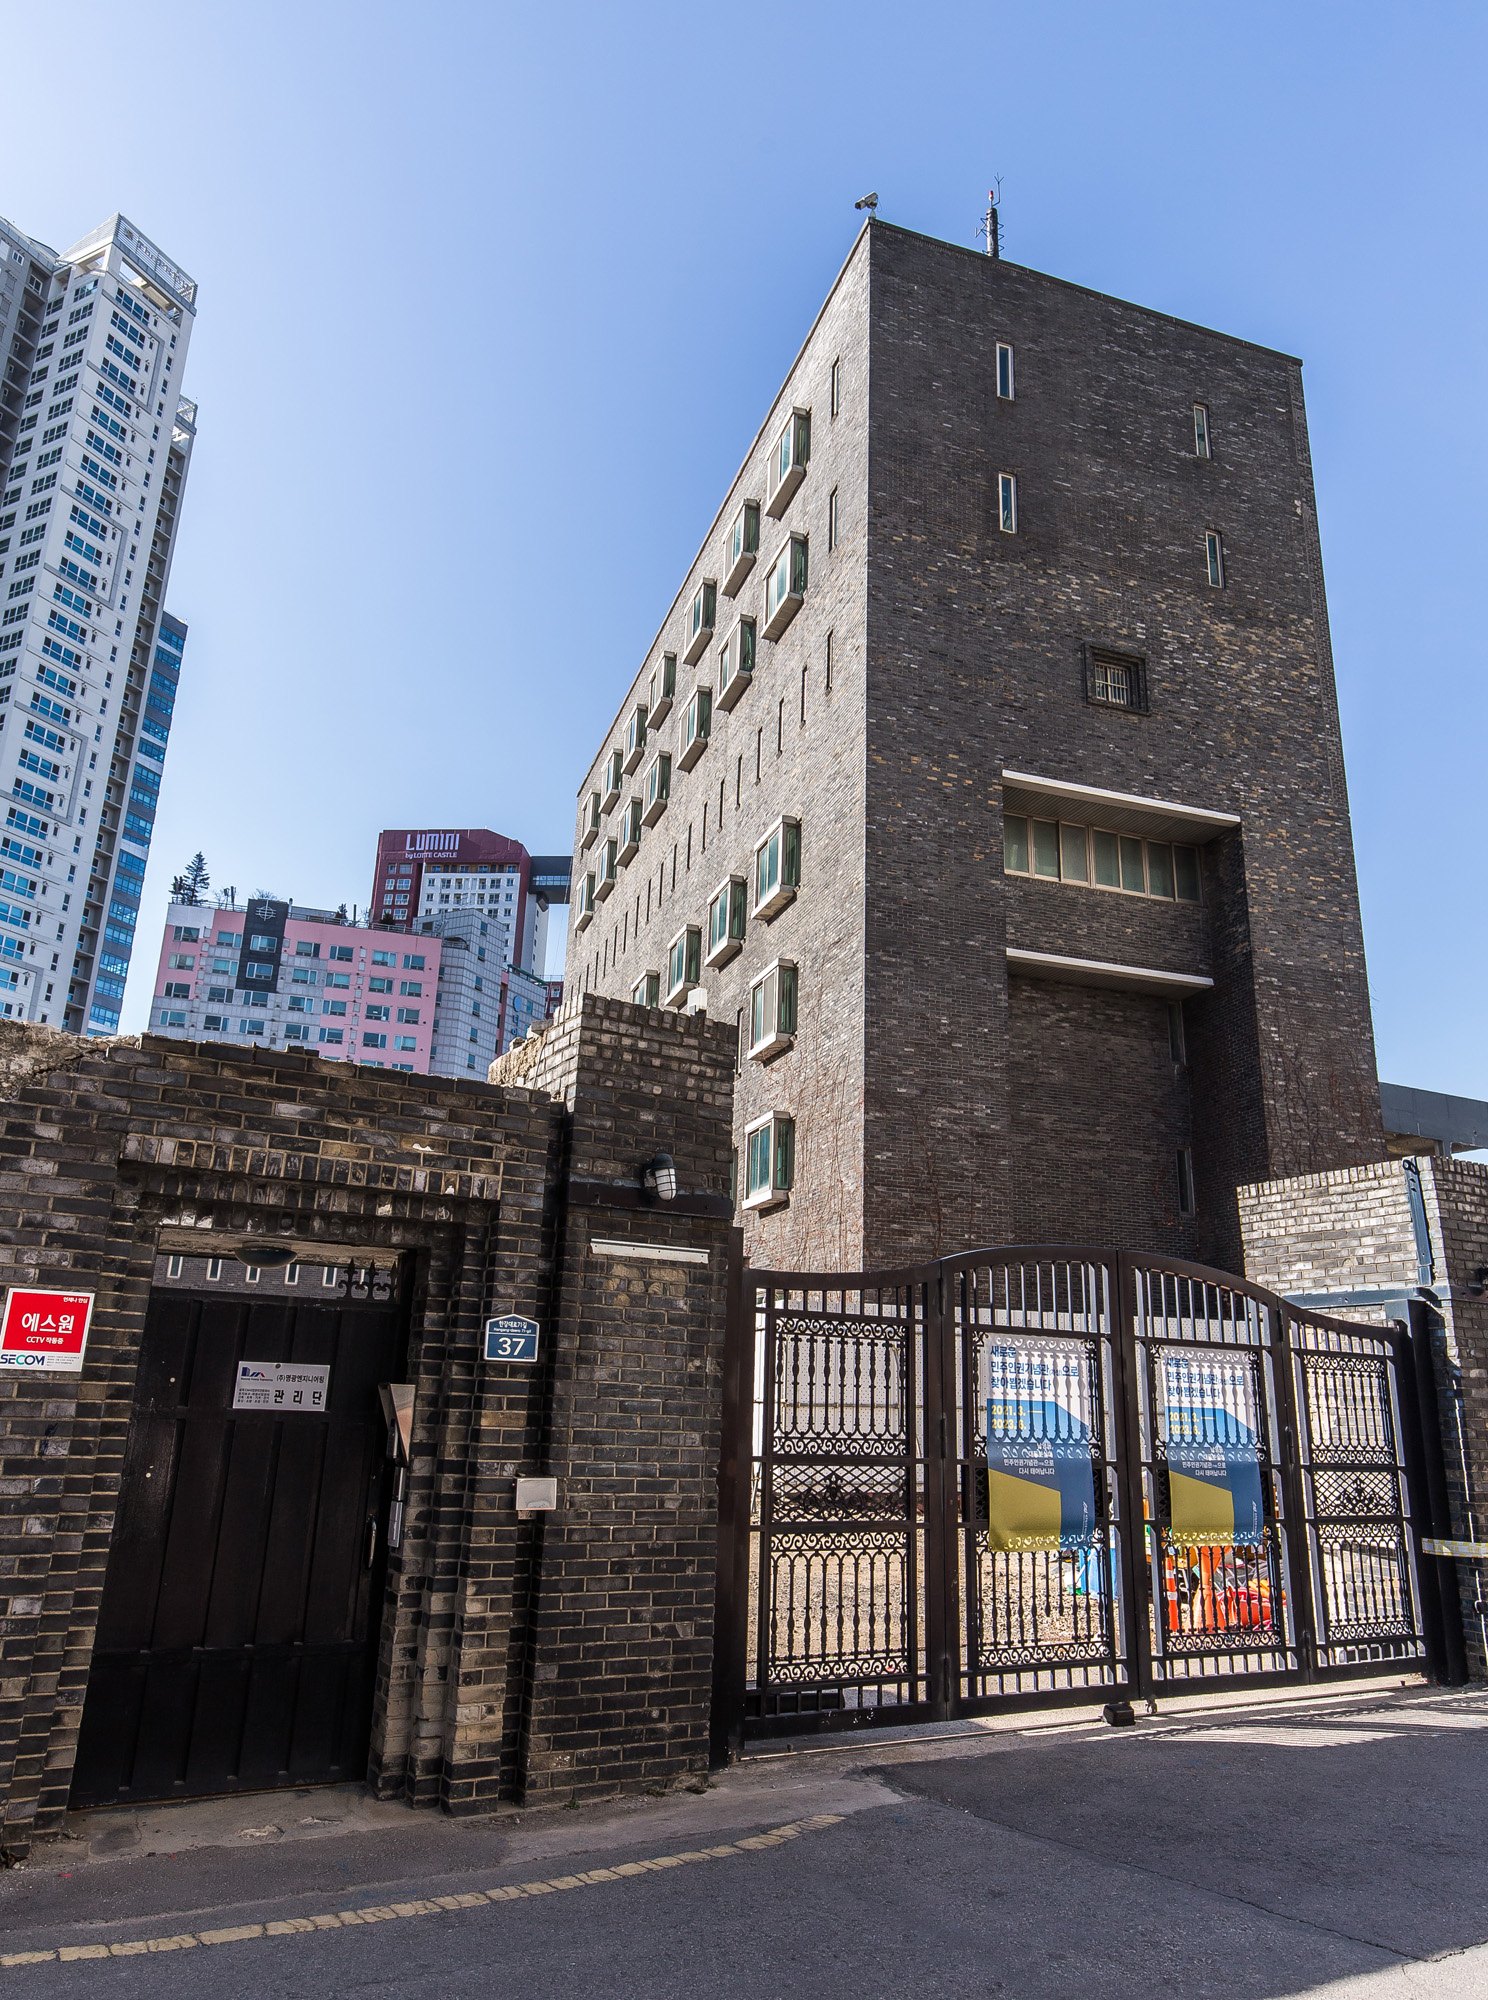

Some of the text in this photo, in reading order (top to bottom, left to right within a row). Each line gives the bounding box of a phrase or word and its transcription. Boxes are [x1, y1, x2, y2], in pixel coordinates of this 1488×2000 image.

[405, 833, 460, 851] LUMINI
[405, 852, 413, 860] by
[21, 1313, 75, 1334] 에스원
[26, 1336, 64, 1345] CCTV 작동중
[497, 1337, 526, 1356] 37
[990, 1345, 1016, 1359] 새로운
[0, 1354, 45, 1366] SECOM
[1166, 1357, 1189, 1370] 새로운
[991, 1376, 1051, 1391] 찾아뵙겠습니다
[1167, 1385, 1220, 1399] 찾아뵙겠습니다
